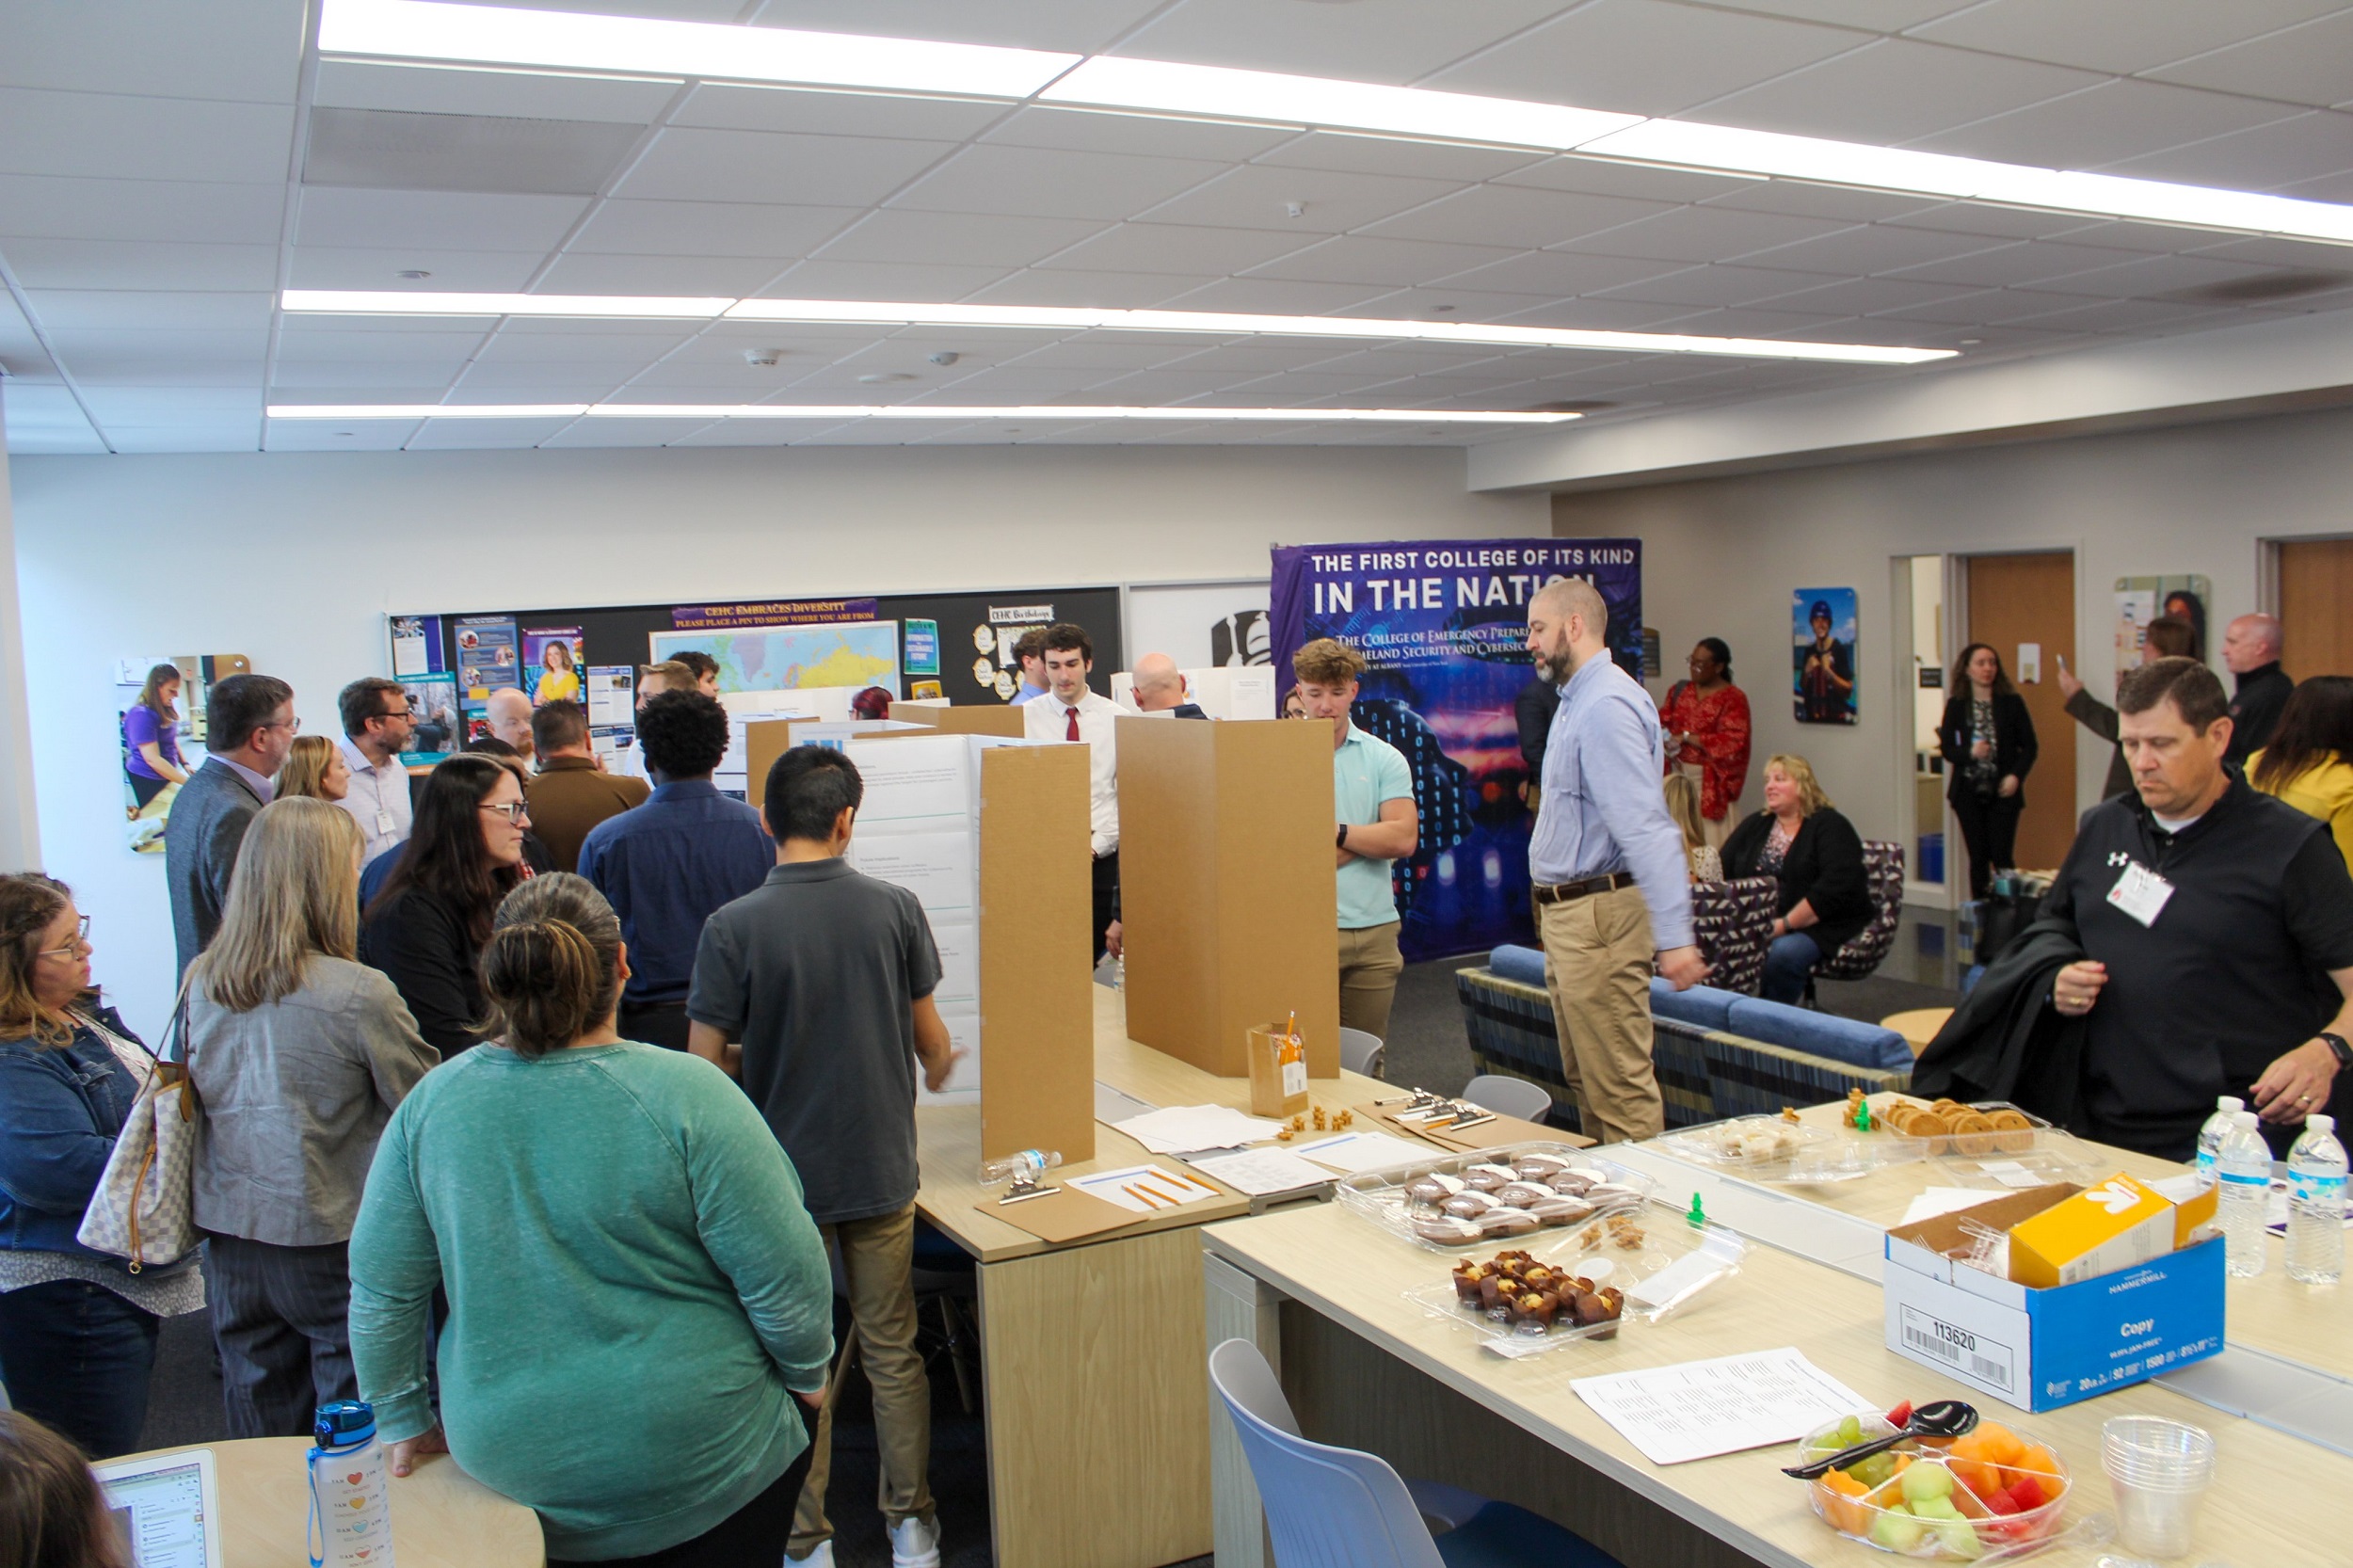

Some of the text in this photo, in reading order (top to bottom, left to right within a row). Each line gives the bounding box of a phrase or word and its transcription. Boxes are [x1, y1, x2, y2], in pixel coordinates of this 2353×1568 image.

[1311, 548, 1634, 572] THE FIRST COLLEGE OF ITS KIND
[1314, 573, 1594, 615] IN THE NATI
[704, 601, 845, 616] CEHC EMBRACES DIVERSITY
[676, 618, 705, 628] PLEASE
[706, 617, 731, 627] PLACE
[738, 616, 752, 625] PIN
[764, 616, 790, 624] SHOW
[791, 615, 818, 623] WHERE
[853, 612, 874, 620] FROM
[1402, 645, 1449, 660] SECURITY
[2108, 1272, 2167, 1294] HAMMERMILL
[1933, 1321, 1976, 1352] 113620
[2120, 1318, 2154, 1337] Copy
[2113, 1367, 2124, 1381] 92
